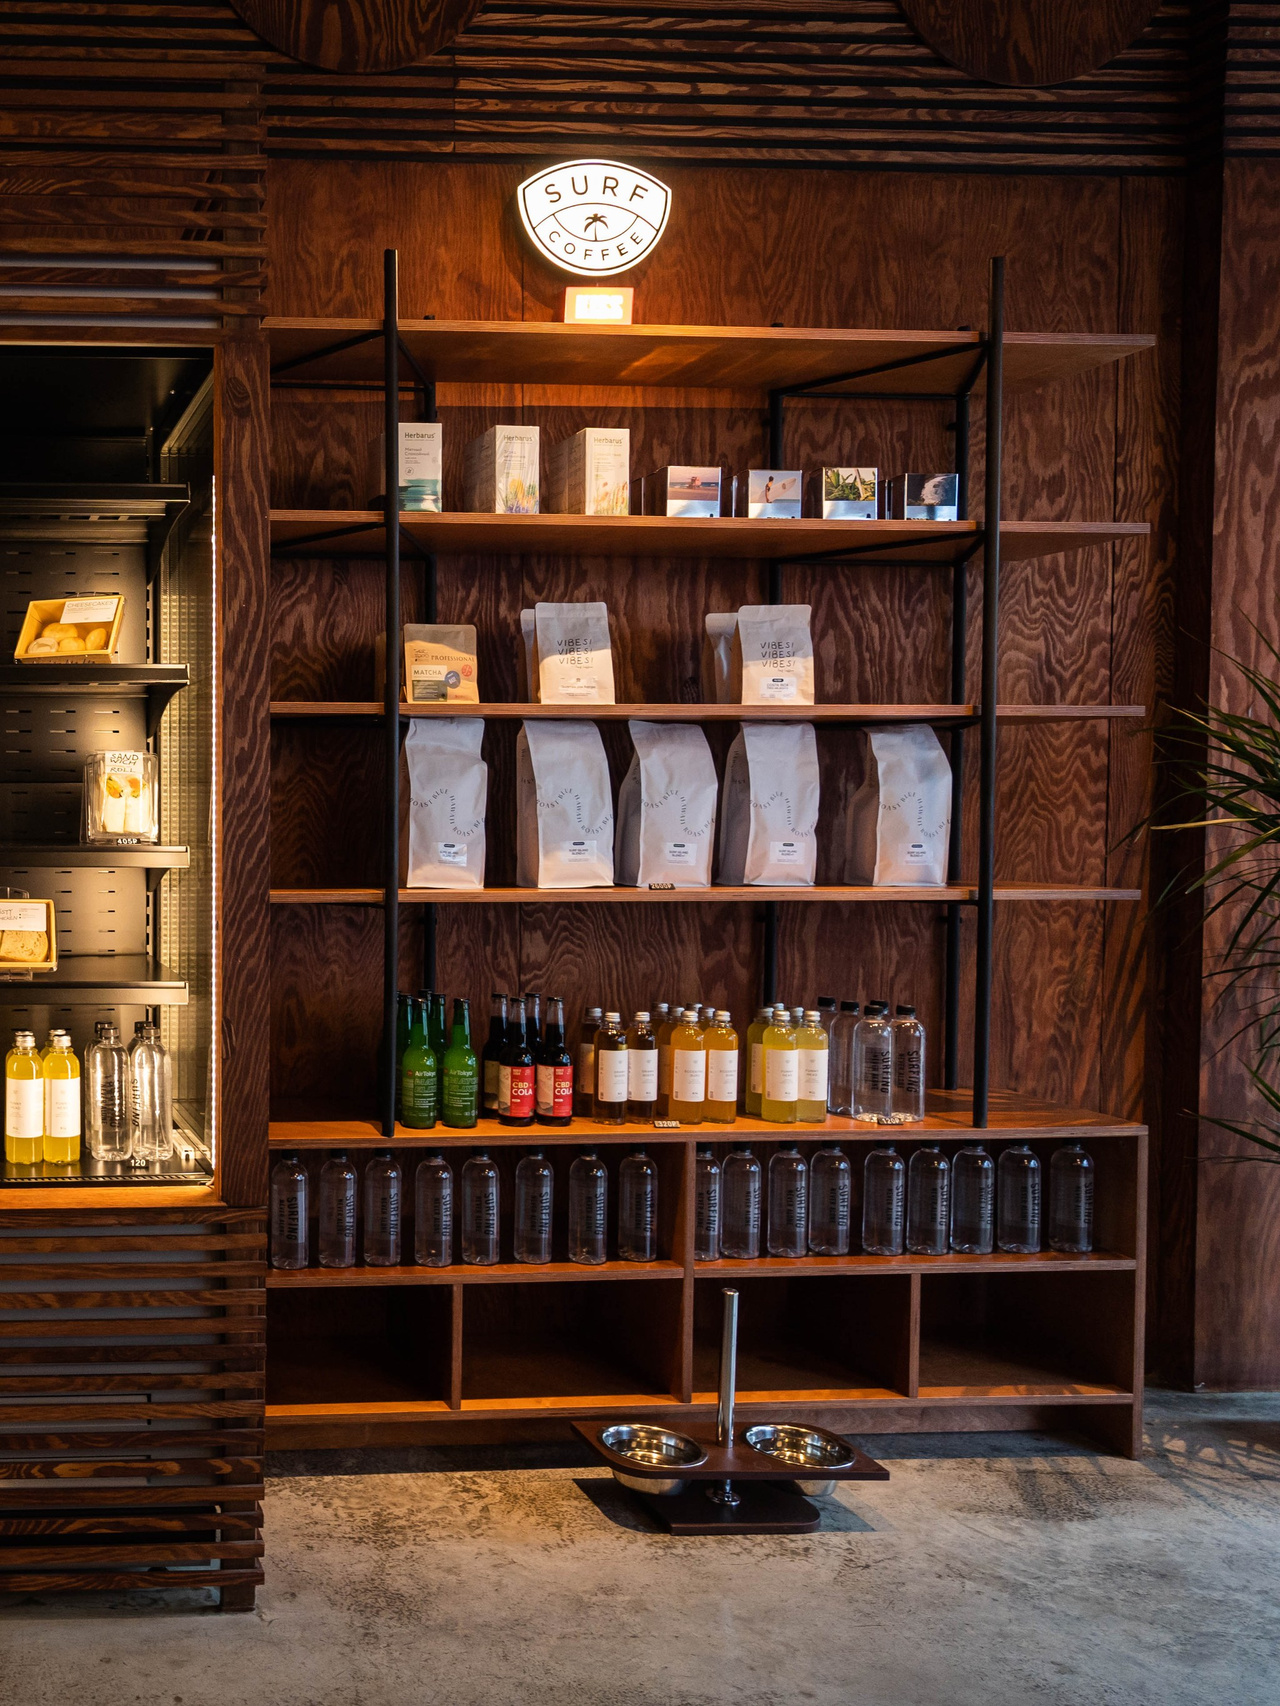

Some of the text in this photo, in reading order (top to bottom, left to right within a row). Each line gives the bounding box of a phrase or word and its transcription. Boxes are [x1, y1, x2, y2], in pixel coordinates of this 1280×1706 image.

[544, 175, 648, 204] SURF
[549, 231, 644, 262] COFFEE
[512, 1088, 533, 1096] COLA
[880, 1051, 890, 1094] SURFING
[906, 1051, 920, 1093] SURFING
[131, 1159, 146, 1167] 120
[286, 1197, 298, 1240] SURFING
[344, 1195, 355, 1238] SURFING
[389, 1193, 399, 1236] SURFING
[441, 1193, 452, 1236] SURFING
[484, 1192, 495, 1236] SURFING
[538, 1192, 550, 1234] SURFING
[594, 1192, 605, 1235] SURFING
[705, 1189, 717, 1232] SURFING
[795, 1186, 806, 1228] SURFING
[838, 1185, 848, 1226] SURFING
[894, 1184, 904, 1227] SURFING
[939, 1185, 948, 1226] SURFING
[1030, 1183, 1040, 1224] SURFING
